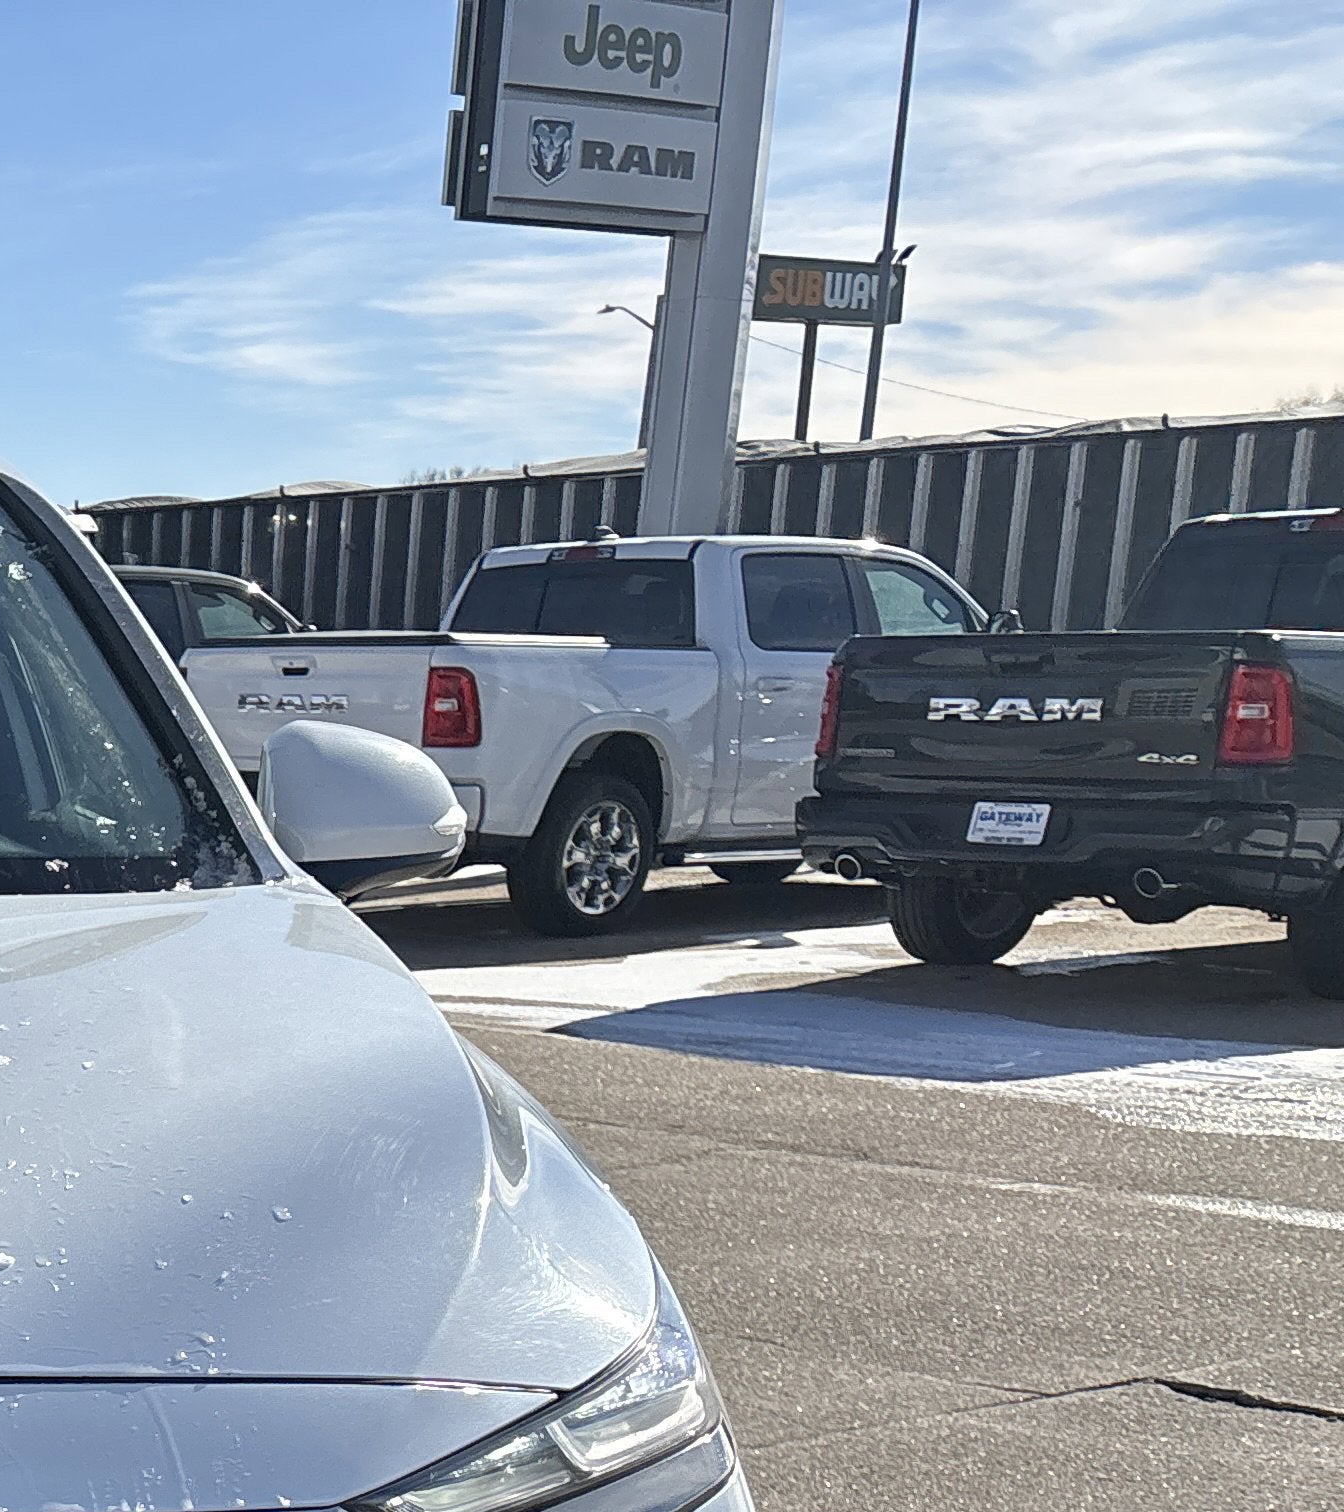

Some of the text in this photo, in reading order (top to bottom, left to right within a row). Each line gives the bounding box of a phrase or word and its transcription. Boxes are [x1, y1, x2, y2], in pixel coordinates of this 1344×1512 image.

[564, 4, 682, 89] Jeep
[580, 139, 696, 181] RAM
[236, 692, 349, 714] RAM
[926, 696, 1104, 722] RAM
